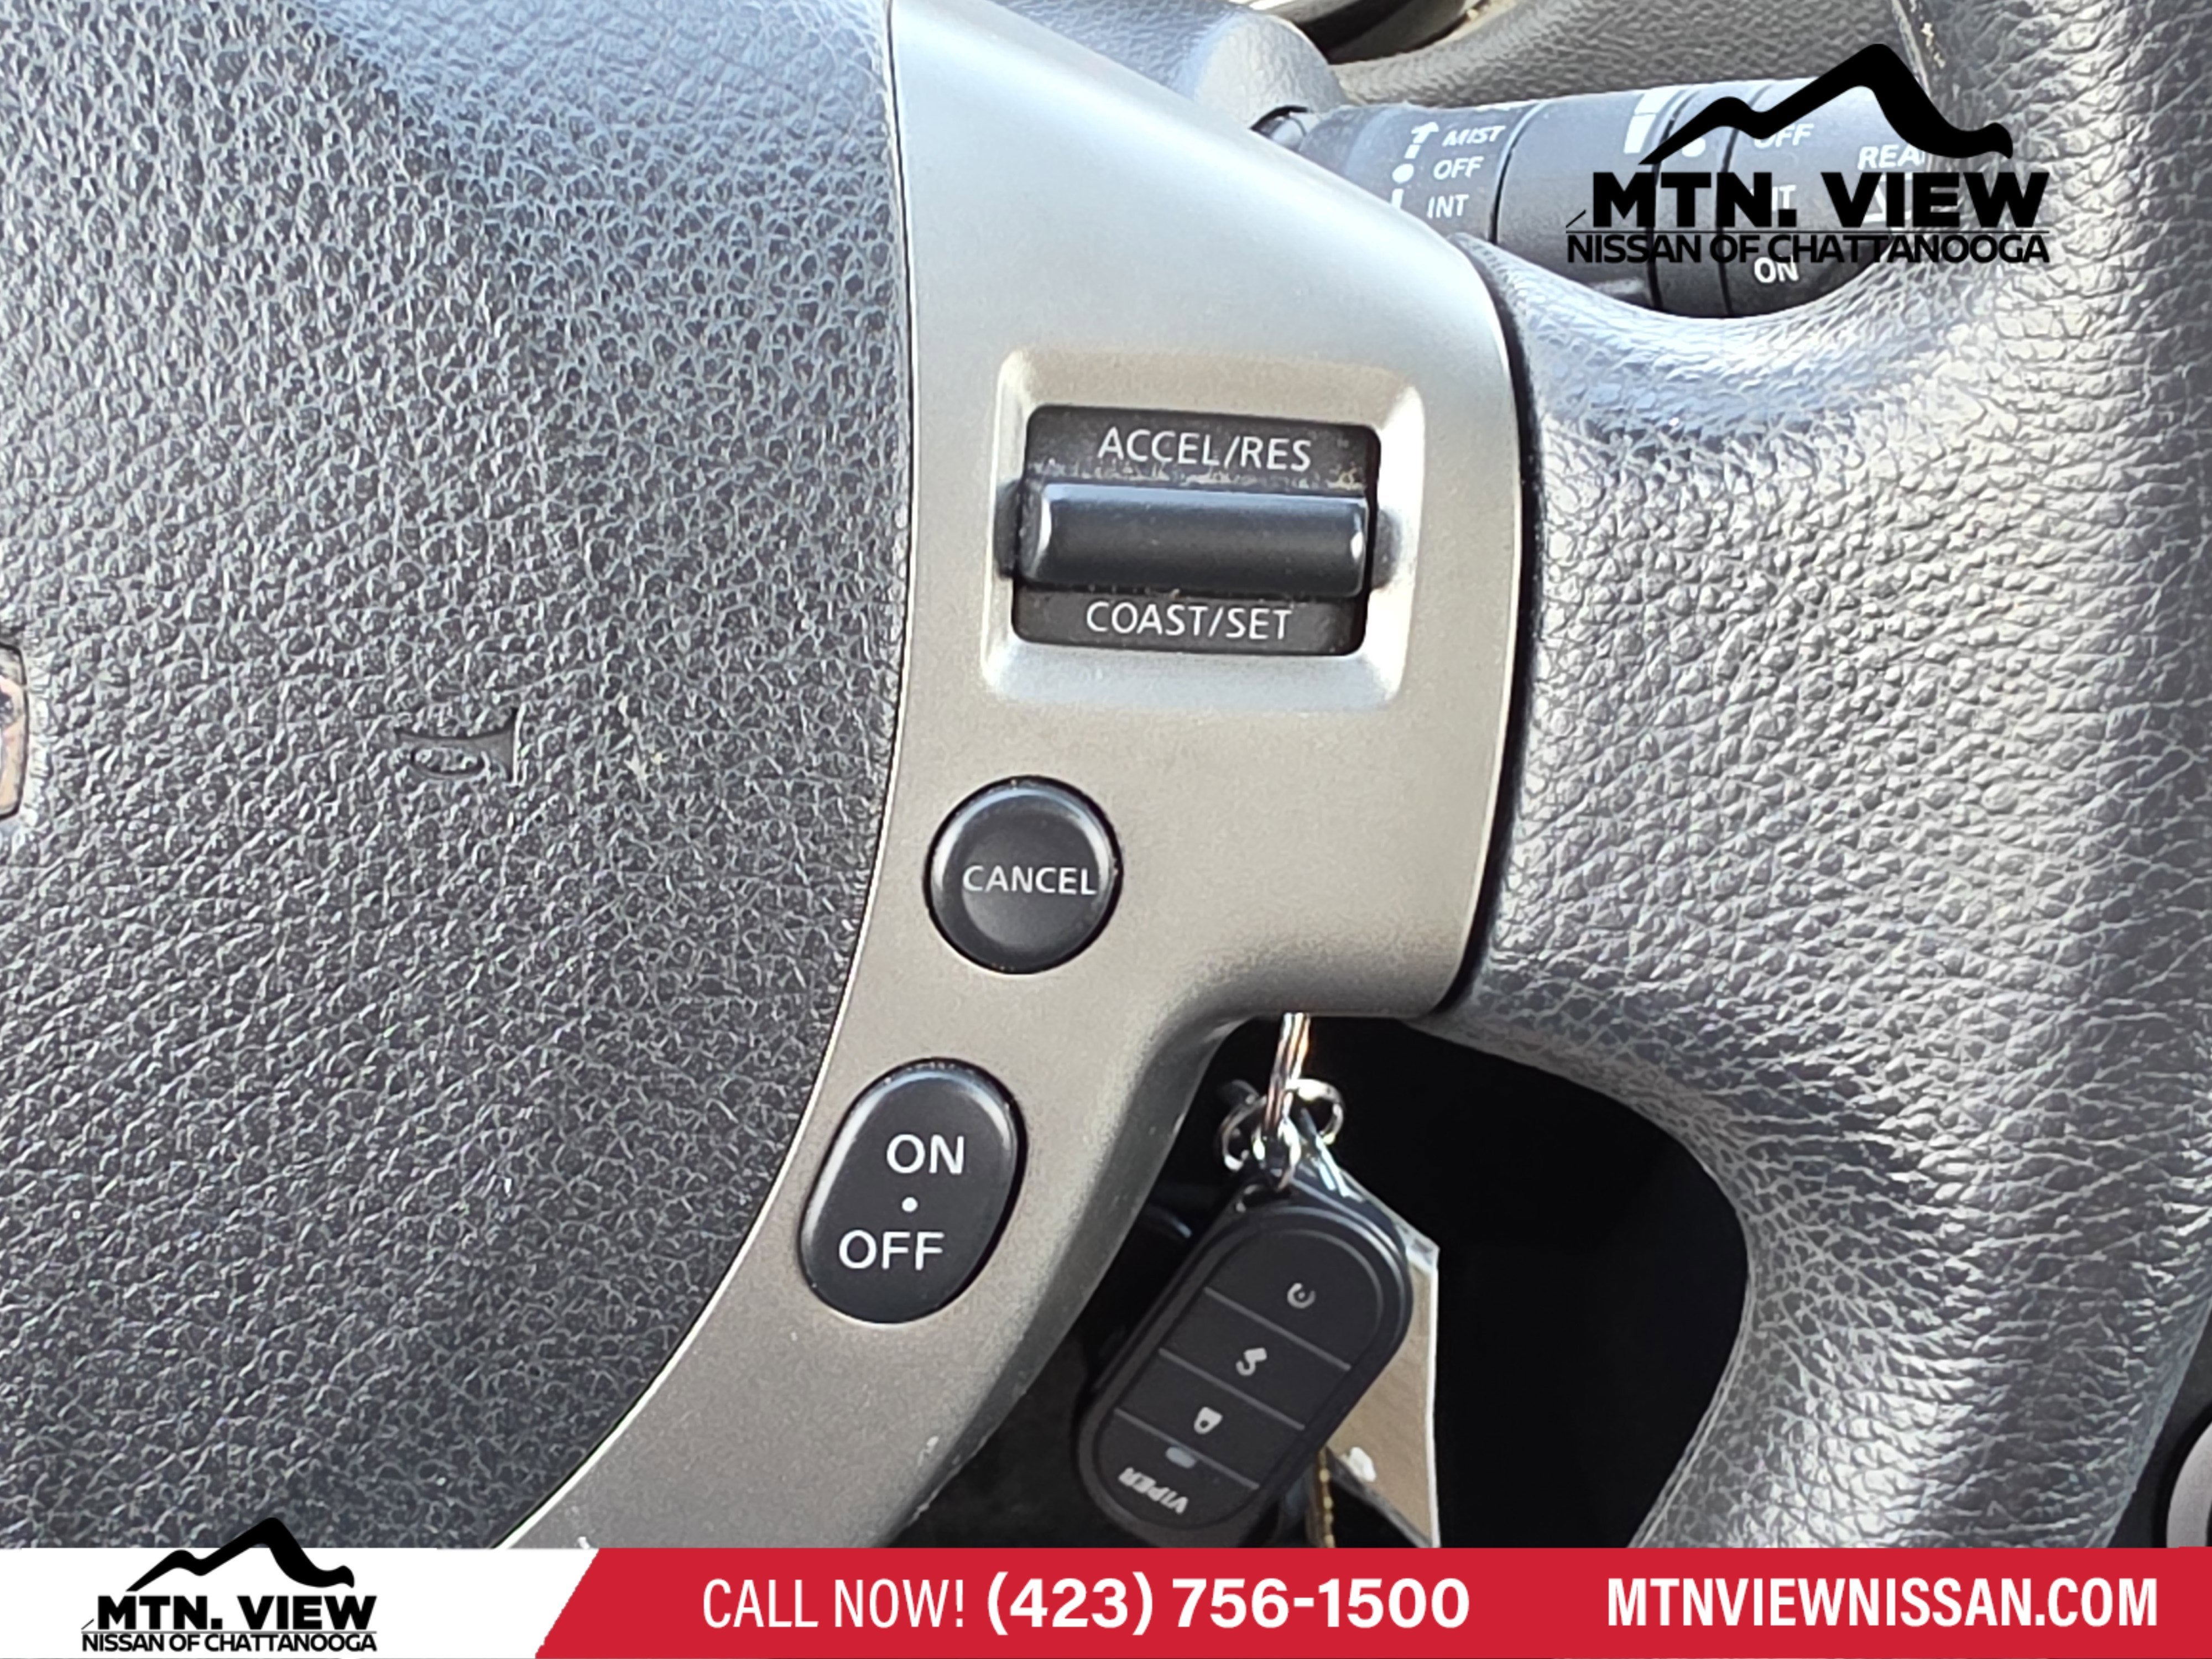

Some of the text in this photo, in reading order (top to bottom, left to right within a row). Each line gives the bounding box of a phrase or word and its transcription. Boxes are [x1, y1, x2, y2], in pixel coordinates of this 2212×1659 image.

[1441, 125, 1506, 147] MIST
[1432, 156, 1484, 180] OFF
[1427, 194, 1470, 218] INT
[1754, 256, 1799, 283] ON
[1096, 426, 1312, 471] ACCEL/RES
[1086, 601, 1293, 640] COAST/SET
[962, 864, 1097, 897] CANCEL
[886, 1134, 965, 1175] ON
[838, 1229, 945, 1271] OFF
[1118, 1467, 1189, 1515] VIPER
